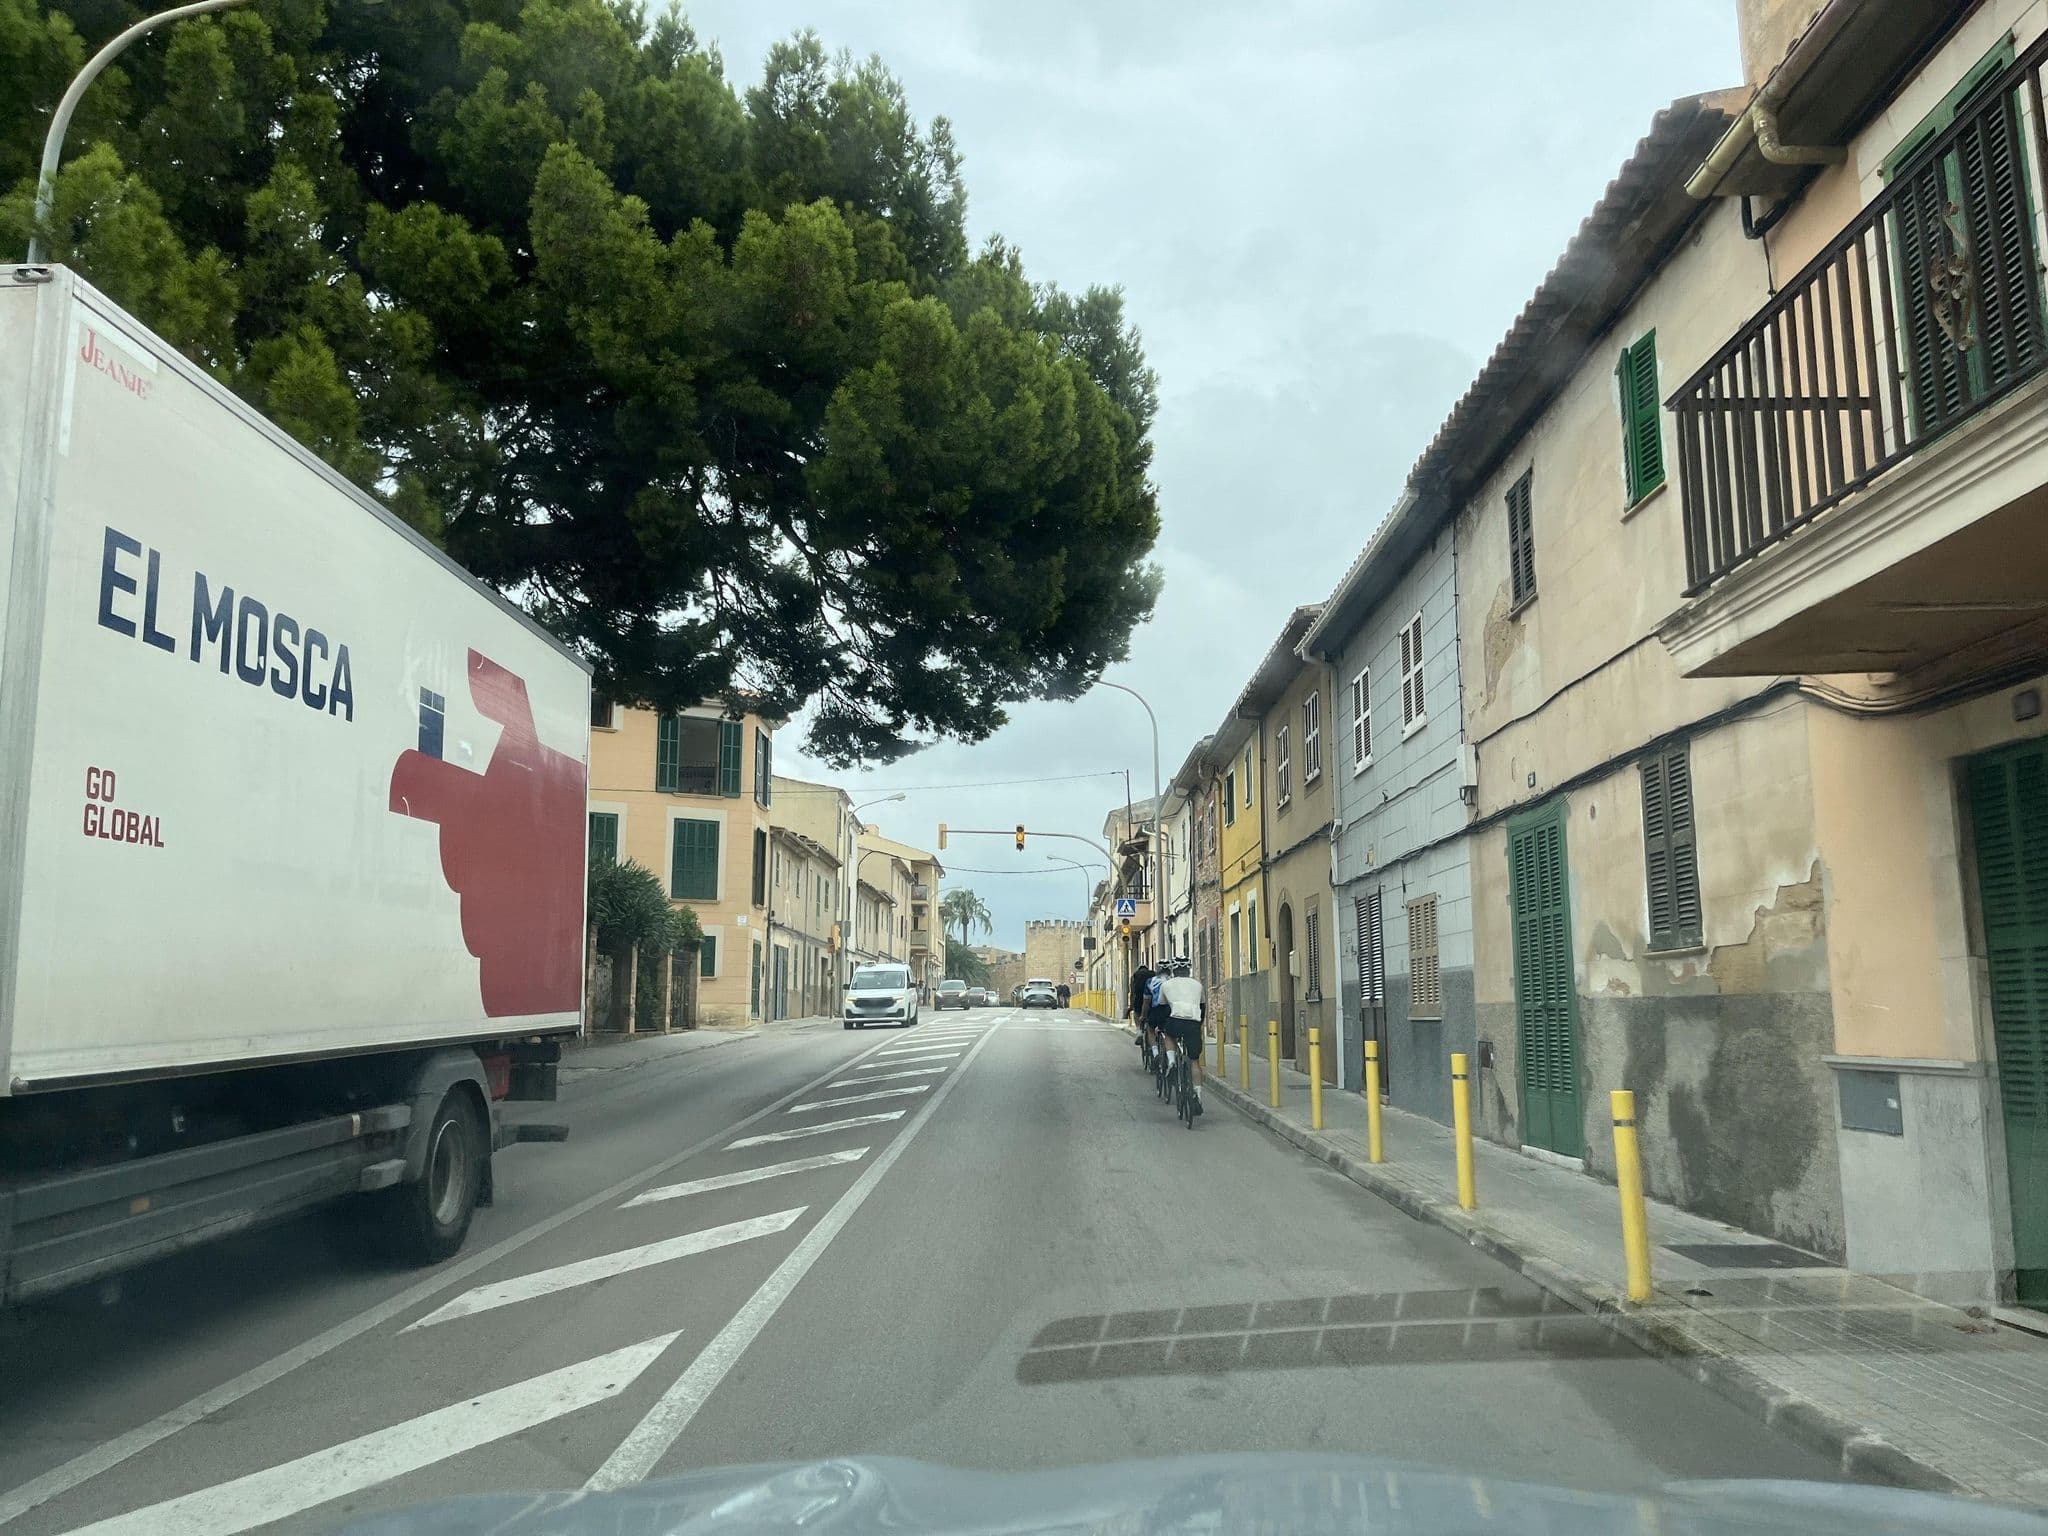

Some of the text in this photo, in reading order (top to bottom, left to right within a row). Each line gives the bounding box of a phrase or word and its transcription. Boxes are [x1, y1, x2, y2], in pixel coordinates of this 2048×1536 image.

[98, 526, 354, 723] EL MOSCA
[86, 766, 116, 802] GO
[83, 803, 164, 848] GLOBAL
